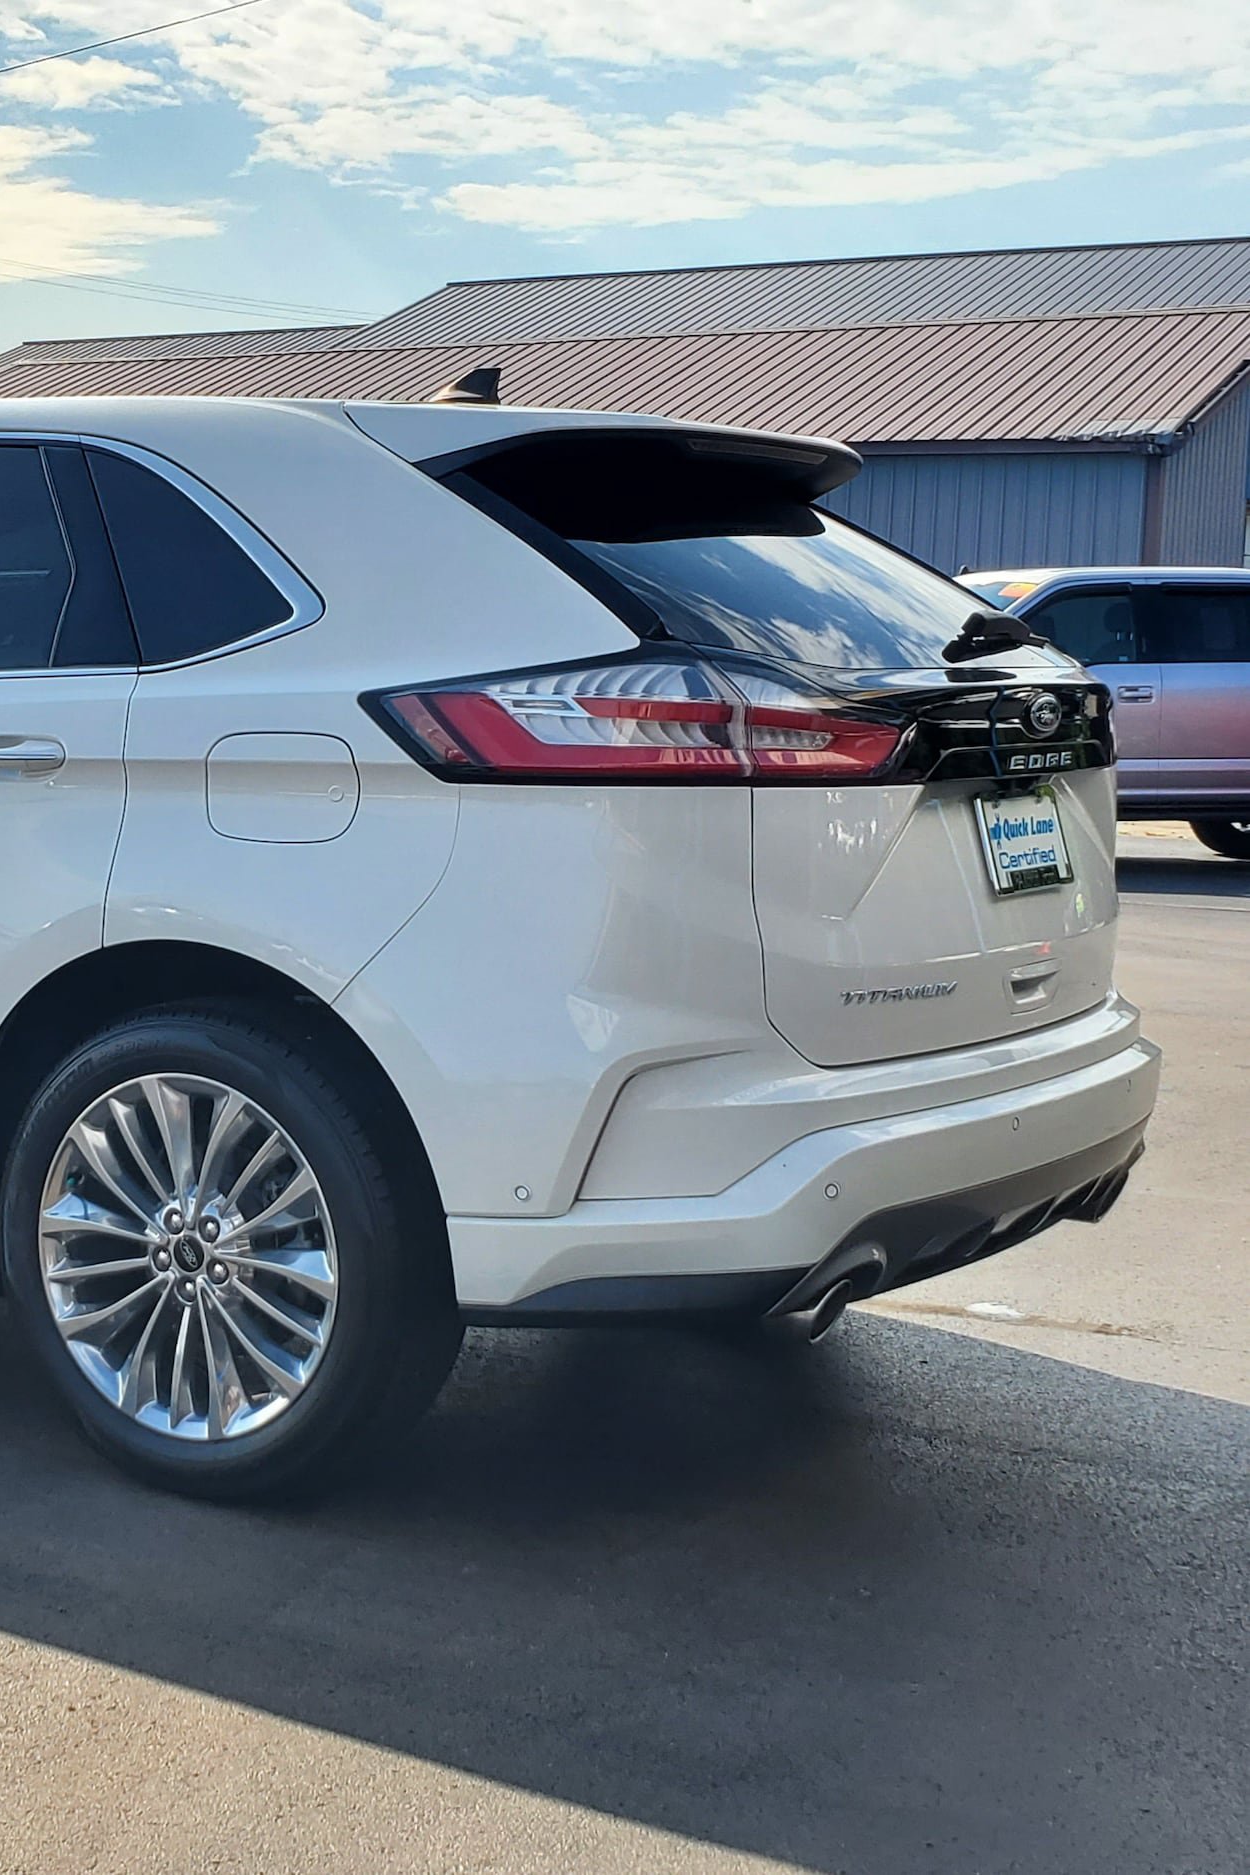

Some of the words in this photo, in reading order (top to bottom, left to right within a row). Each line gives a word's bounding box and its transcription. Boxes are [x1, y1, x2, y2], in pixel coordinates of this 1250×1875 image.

[1008, 751, 1072, 770] EDGE
[1003, 817, 1029, 841] Quick
[1030, 816, 1054, 835] Lane
[998, 845, 1057, 869] Certified
[840, 981, 958, 1006] TITANIUM
